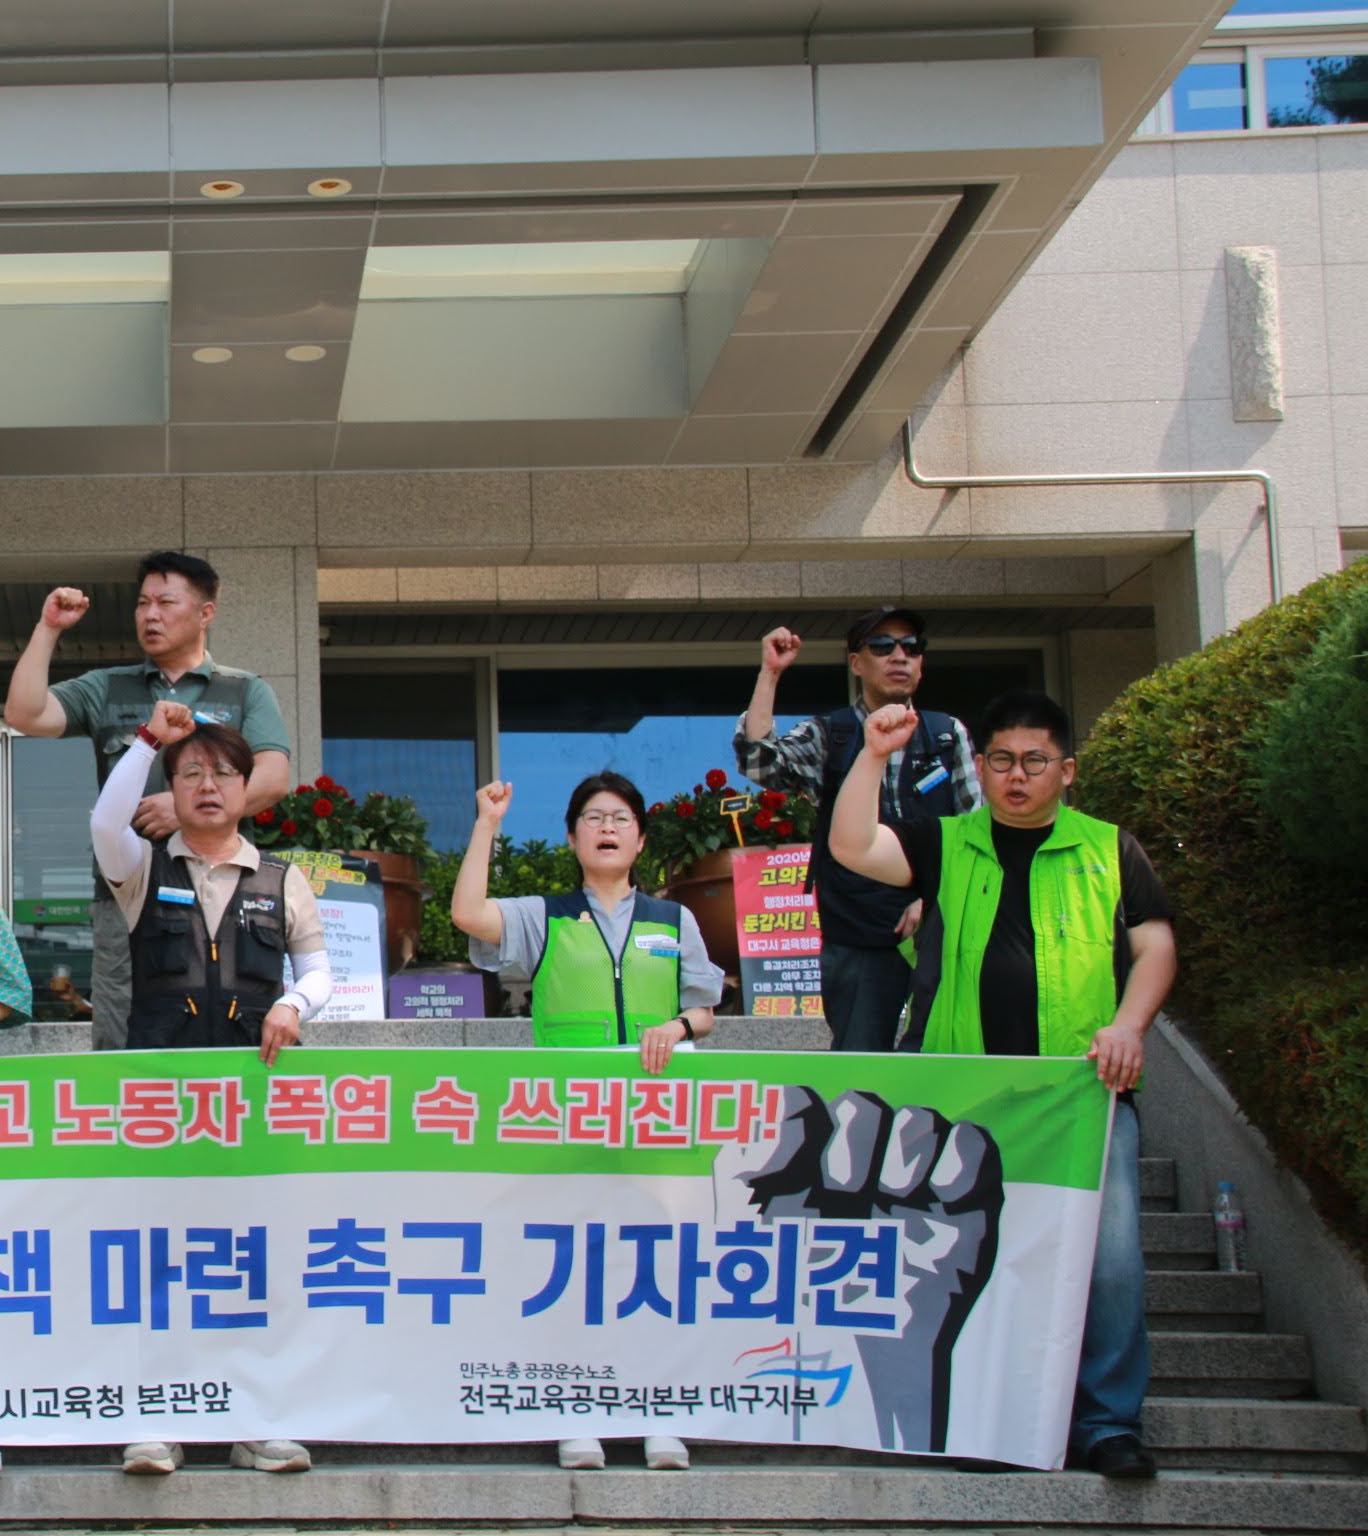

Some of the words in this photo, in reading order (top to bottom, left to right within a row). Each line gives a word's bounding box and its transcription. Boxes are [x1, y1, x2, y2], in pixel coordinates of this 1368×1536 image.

[743, 911, 806, 934] 둔갑시킨
[747, 939, 778, 952] 대구시
[52, 1076, 249, 1148] 노동자
[264, 1074, 391, 1145] 폭염
[412, 1075, 479, 1145] 속
[497, 1076, 785, 1149] 쓰러진다!
[89, 1225, 269, 1331] 마련
[302, 1218, 486, 1325] 촉구
[521, 1219, 900, 1331] 기자회견
[459, 1362, 520, 1380] 민주노총
[524, 1362, 617, 1381] 공공운수노조
[137, 1380, 233, 1416] 본관앞
[459, 1384, 704, 1416] 전국교육공무직본부
[710, 1385, 820, 1416] 대구지부
